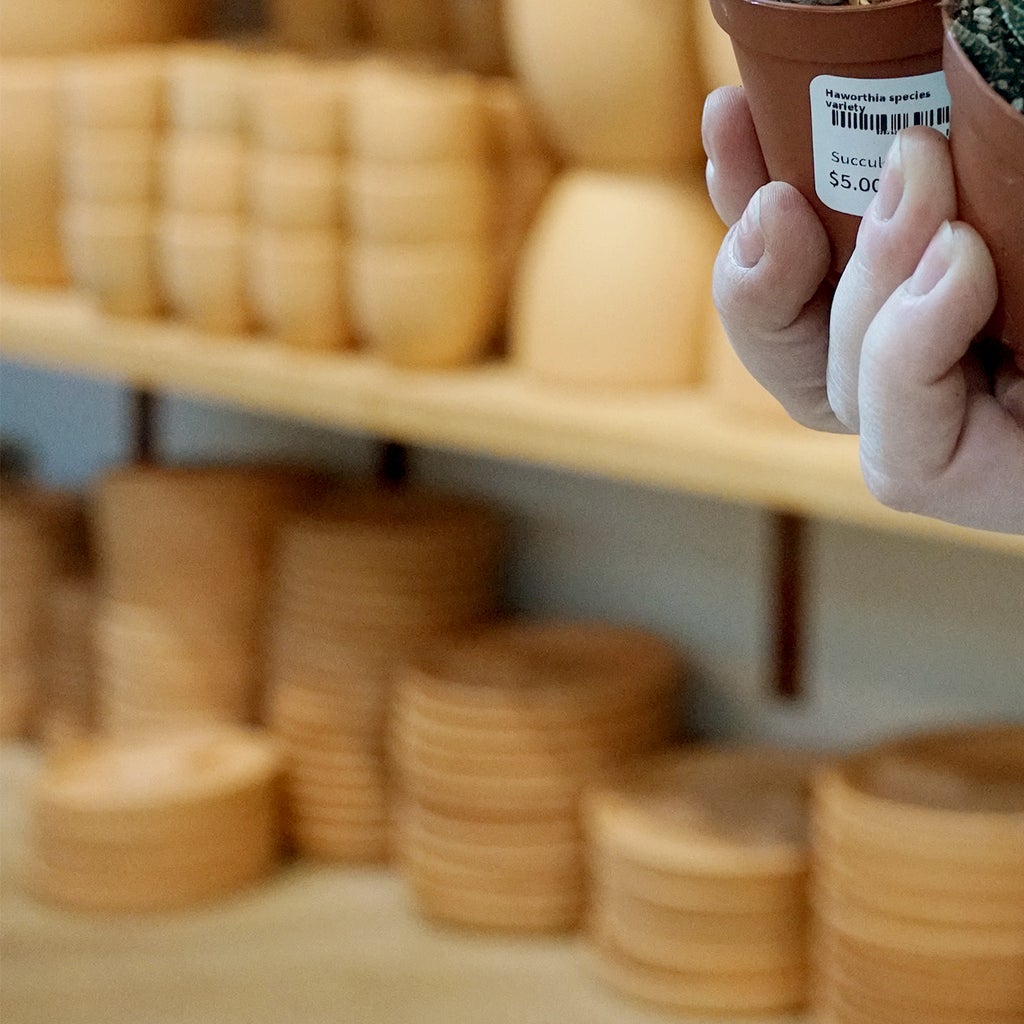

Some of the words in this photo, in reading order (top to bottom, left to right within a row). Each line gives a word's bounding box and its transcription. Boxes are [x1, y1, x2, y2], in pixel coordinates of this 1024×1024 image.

[825, 88, 886, 103] Haworthia
[889, 90, 931, 104] species
[825, 100, 866, 113] variety
[831, 151, 884, 168] Succul
